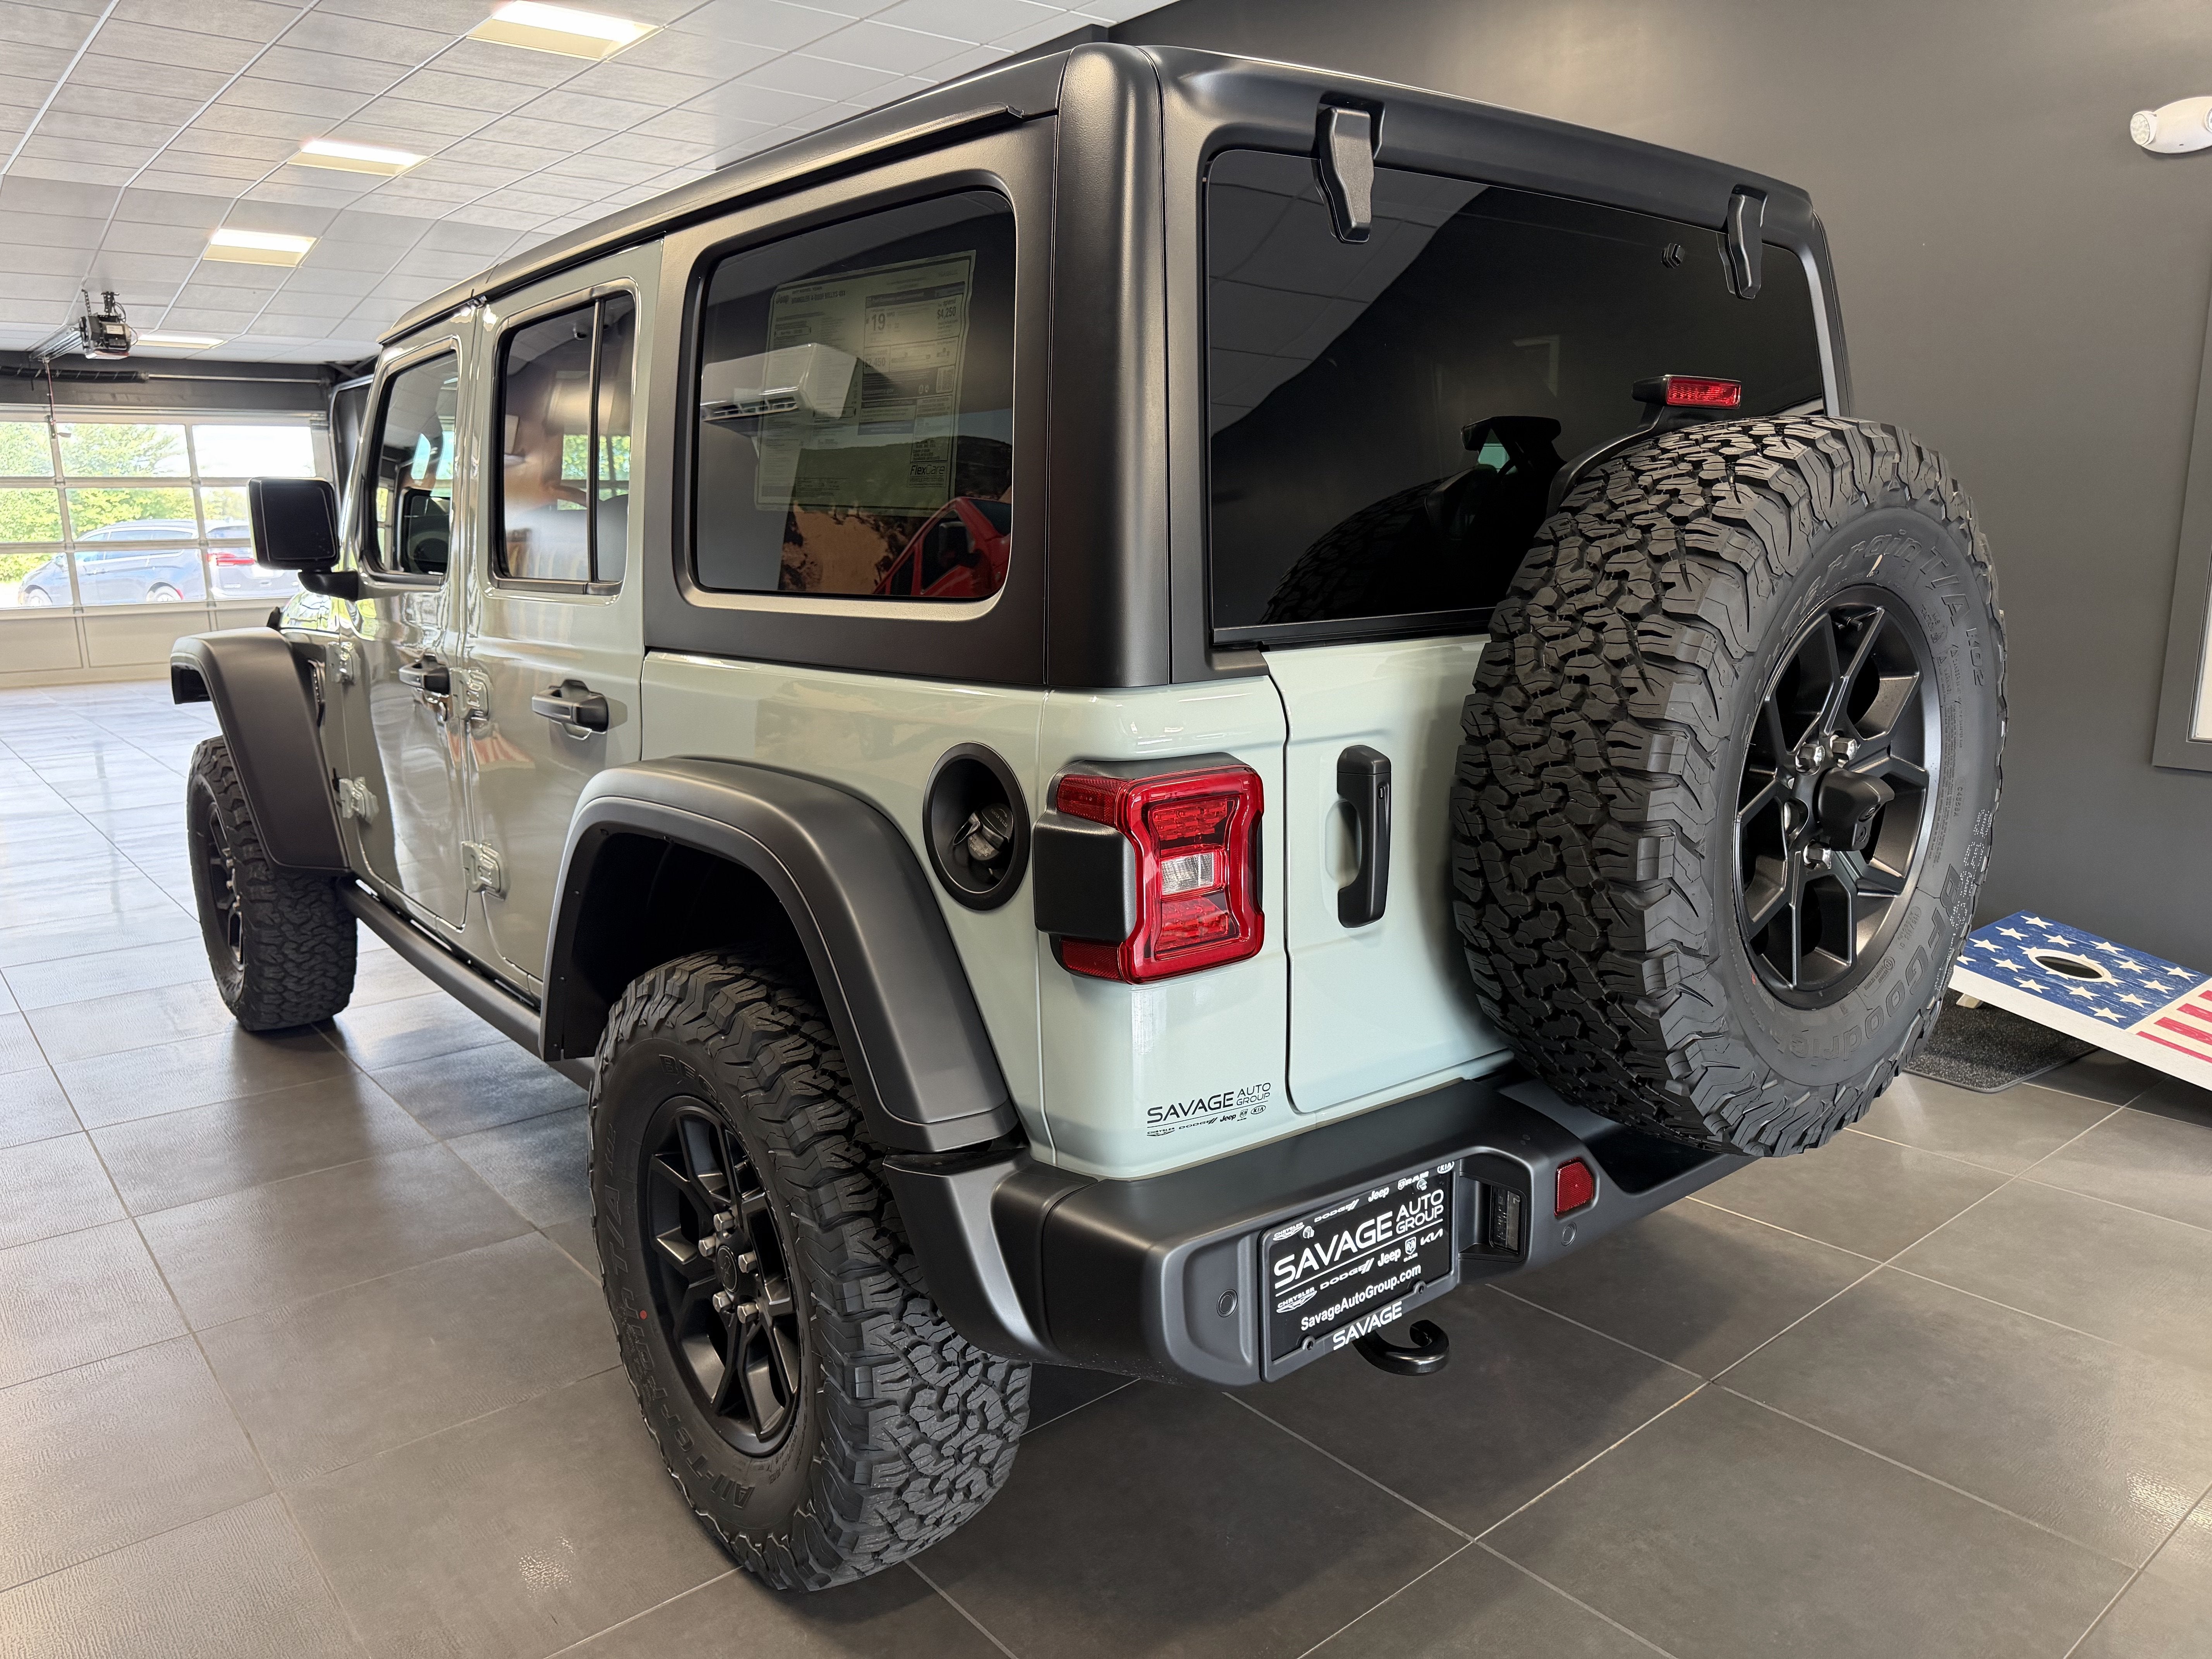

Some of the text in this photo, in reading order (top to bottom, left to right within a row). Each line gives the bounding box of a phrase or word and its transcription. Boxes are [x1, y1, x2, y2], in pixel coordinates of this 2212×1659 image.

[872, 313, 886, 331] 19
[937, 306, 956, 320] $4,250
[910, 465, 945, 476] FlexCare
[1147, 1082, 1271, 1123] SAVAGE AUTO
[1237, 1092, 1270, 1106] GROUP
[1220, 1114, 1237, 1122] Jeep
[1368, 1186, 1389, 1202] Jeep
[1396, 1205, 1444, 1235] GROUP
[1274, 1211, 1393, 1288] SAVAGE
[1396, 1189, 1444, 1221] AUTO
[1277, 1288, 1315, 1309] CHRYSLER
[1377, 1249, 1401, 1267] Jeep
[1301, 1264, 1421, 1331] SavageAutoGroup.com
[1333, 1301, 1403, 1350] SAVAGE
